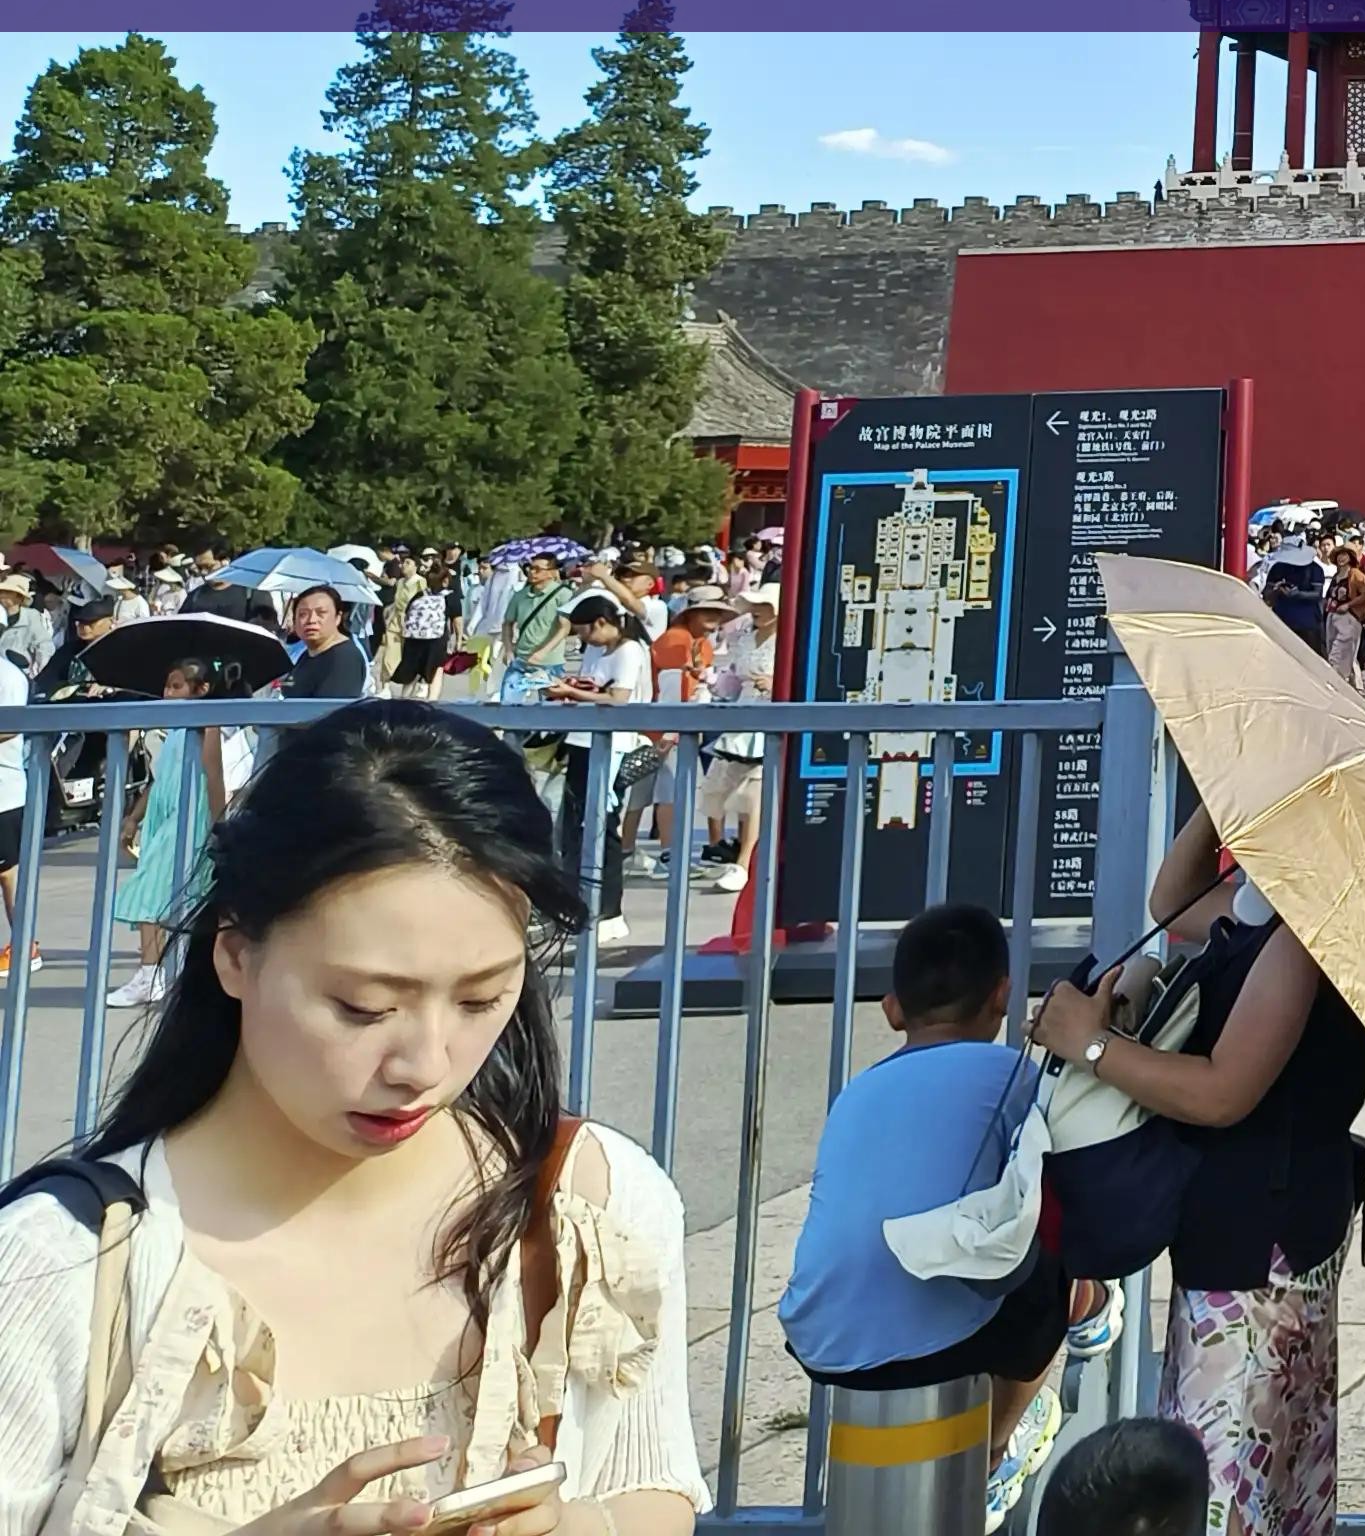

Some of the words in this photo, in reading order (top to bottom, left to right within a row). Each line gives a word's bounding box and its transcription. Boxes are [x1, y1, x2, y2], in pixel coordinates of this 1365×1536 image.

[858, 422, 992, 442] 故宫博物院平面图
[873, 443, 890, 452] Map
